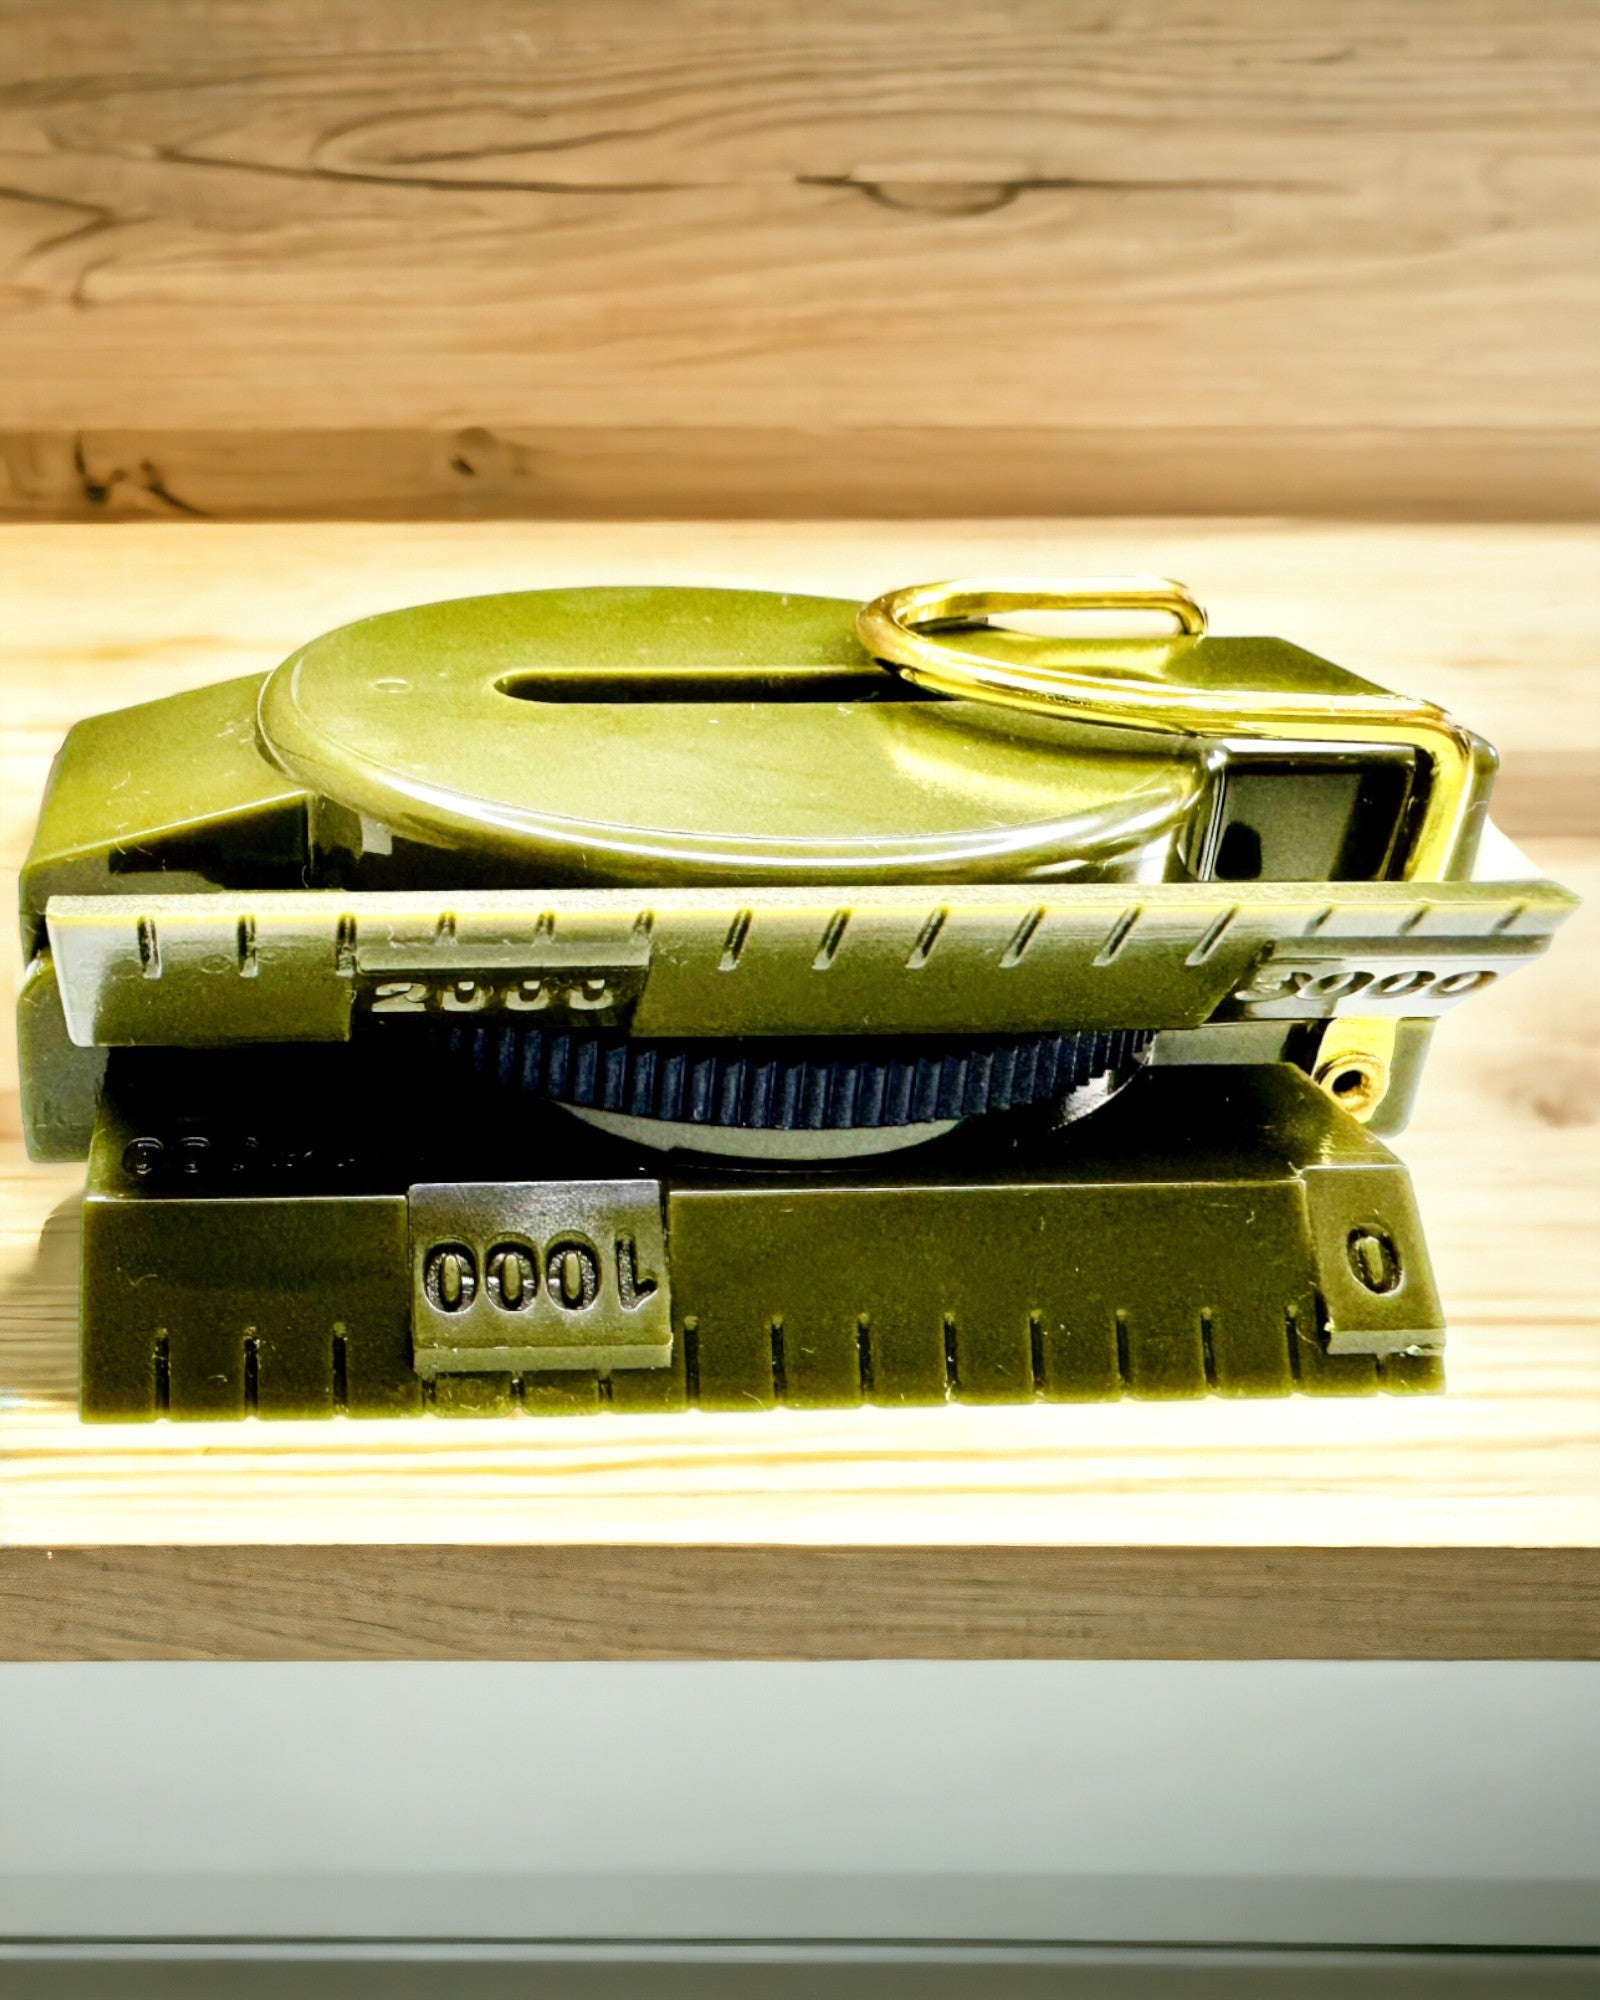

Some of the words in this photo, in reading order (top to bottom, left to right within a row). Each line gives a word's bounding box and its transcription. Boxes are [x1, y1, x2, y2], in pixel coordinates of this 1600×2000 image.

[370, 973, 614, 1012] 2000
[1234, 970, 1499, 1000] 3000
[423, 1232, 658, 1314] 1000
[1346, 1223, 1404, 1296] 0
